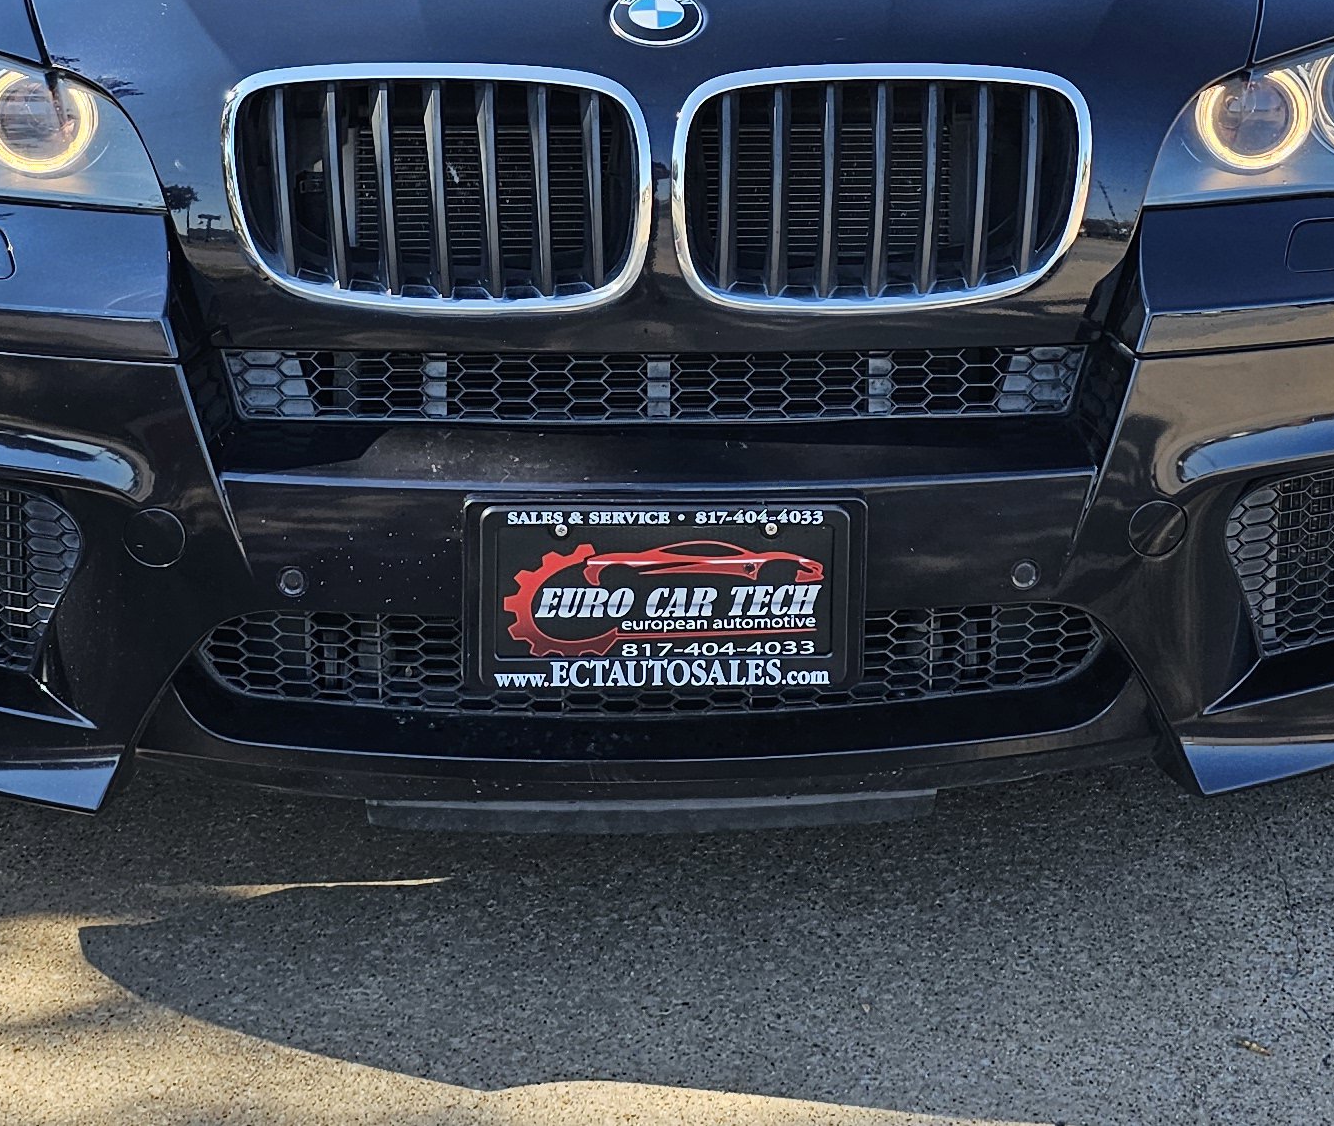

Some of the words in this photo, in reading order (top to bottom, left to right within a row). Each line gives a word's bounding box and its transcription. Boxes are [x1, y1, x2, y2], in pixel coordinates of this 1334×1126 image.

[507, 511, 564, 525] SALES
[567, 512, 584, 524] &
[588, 511, 670, 525] SERVICE
[694, 509, 824, 525] 817-404-4033
[535, 587, 635, 619] EURO
[645, 586, 719, 618] CAR
[729, 584, 822, 617] TECH
[621, 617, 708, 632] european
[712, 614, 817, 630] automotive
[621, 640, 815, 657] 817-404-4033
[494, 659, 831, 687] www.ECTAUTOSALES.com
